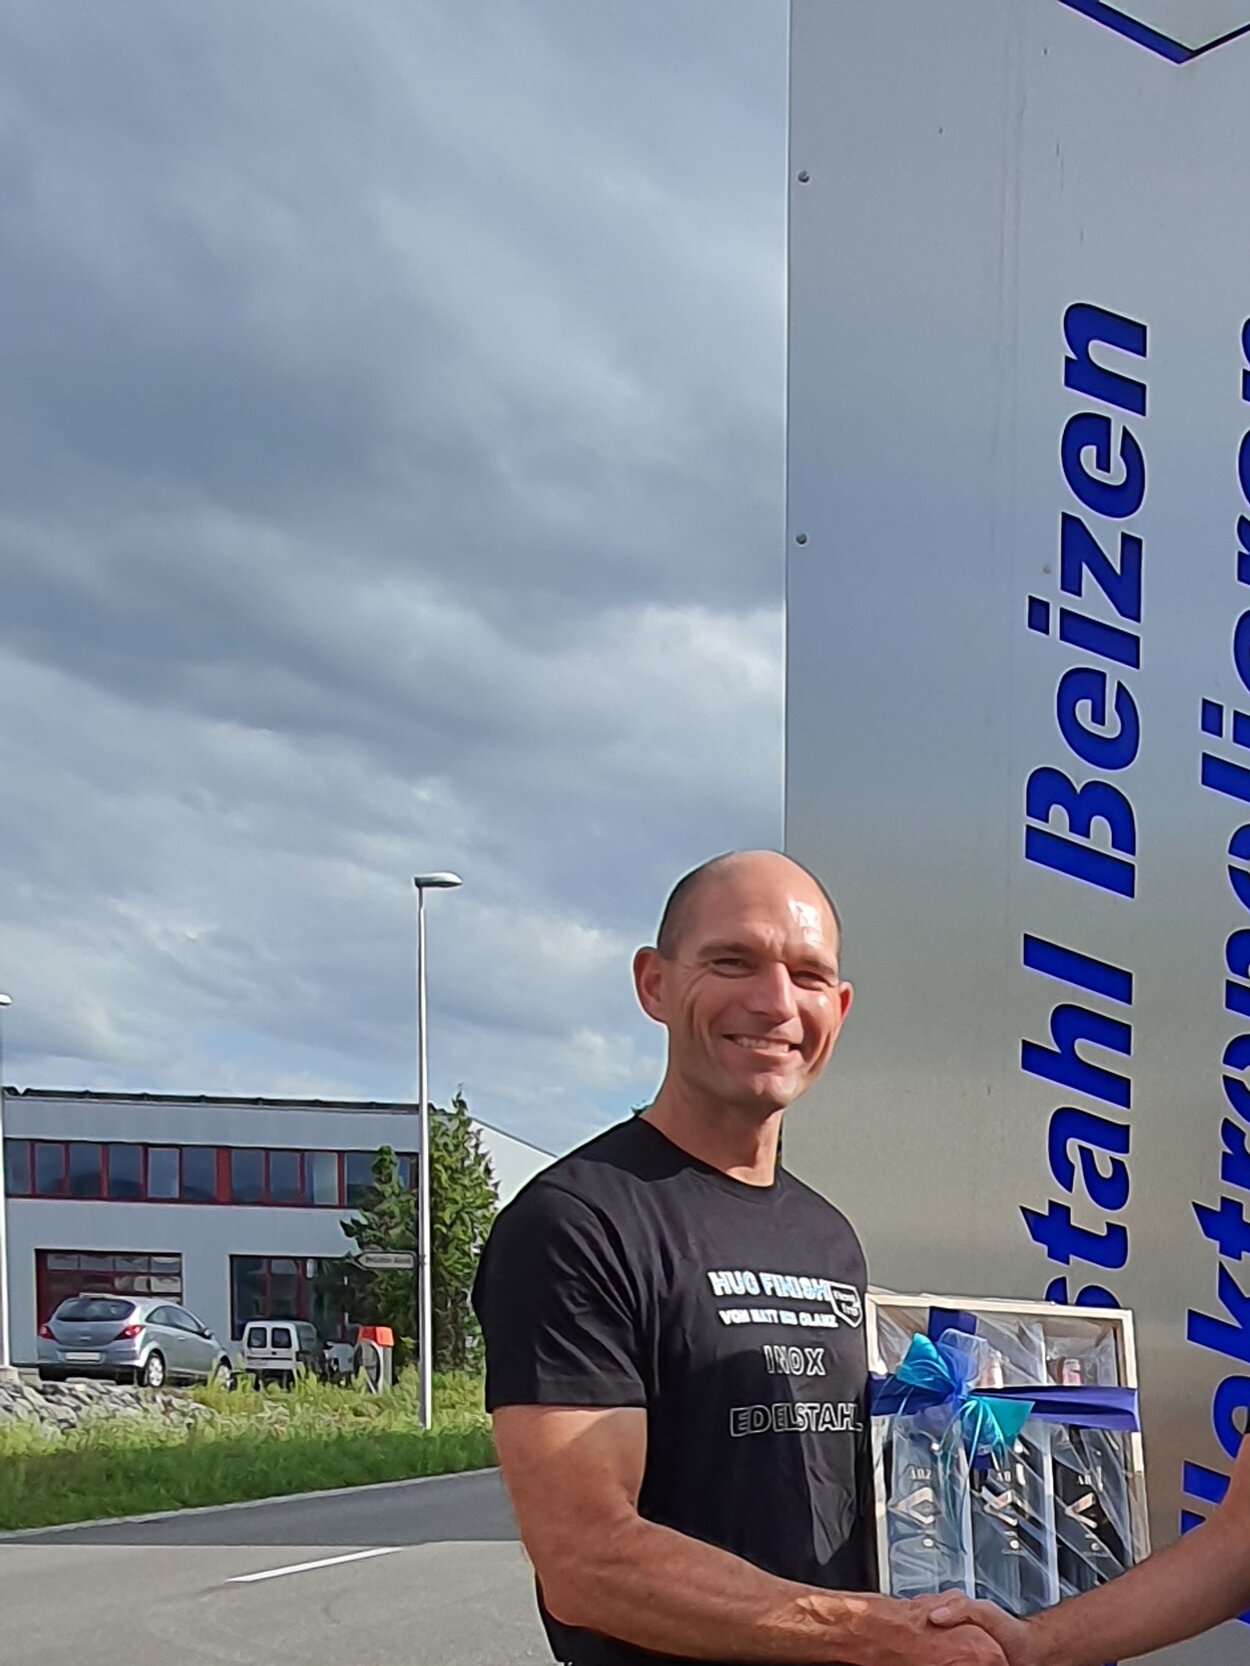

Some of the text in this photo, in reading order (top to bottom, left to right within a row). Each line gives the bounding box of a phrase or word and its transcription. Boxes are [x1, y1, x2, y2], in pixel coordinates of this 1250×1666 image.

[1024, 302, 1148, 900] Beizen
[707, 1270, 761, 1296] HUG
[758, 1272, 831, 1302] FINISH
[762, 1344, 826, 1376] INOX
[729, 1402, 863, 1437] EDELSTAHL
